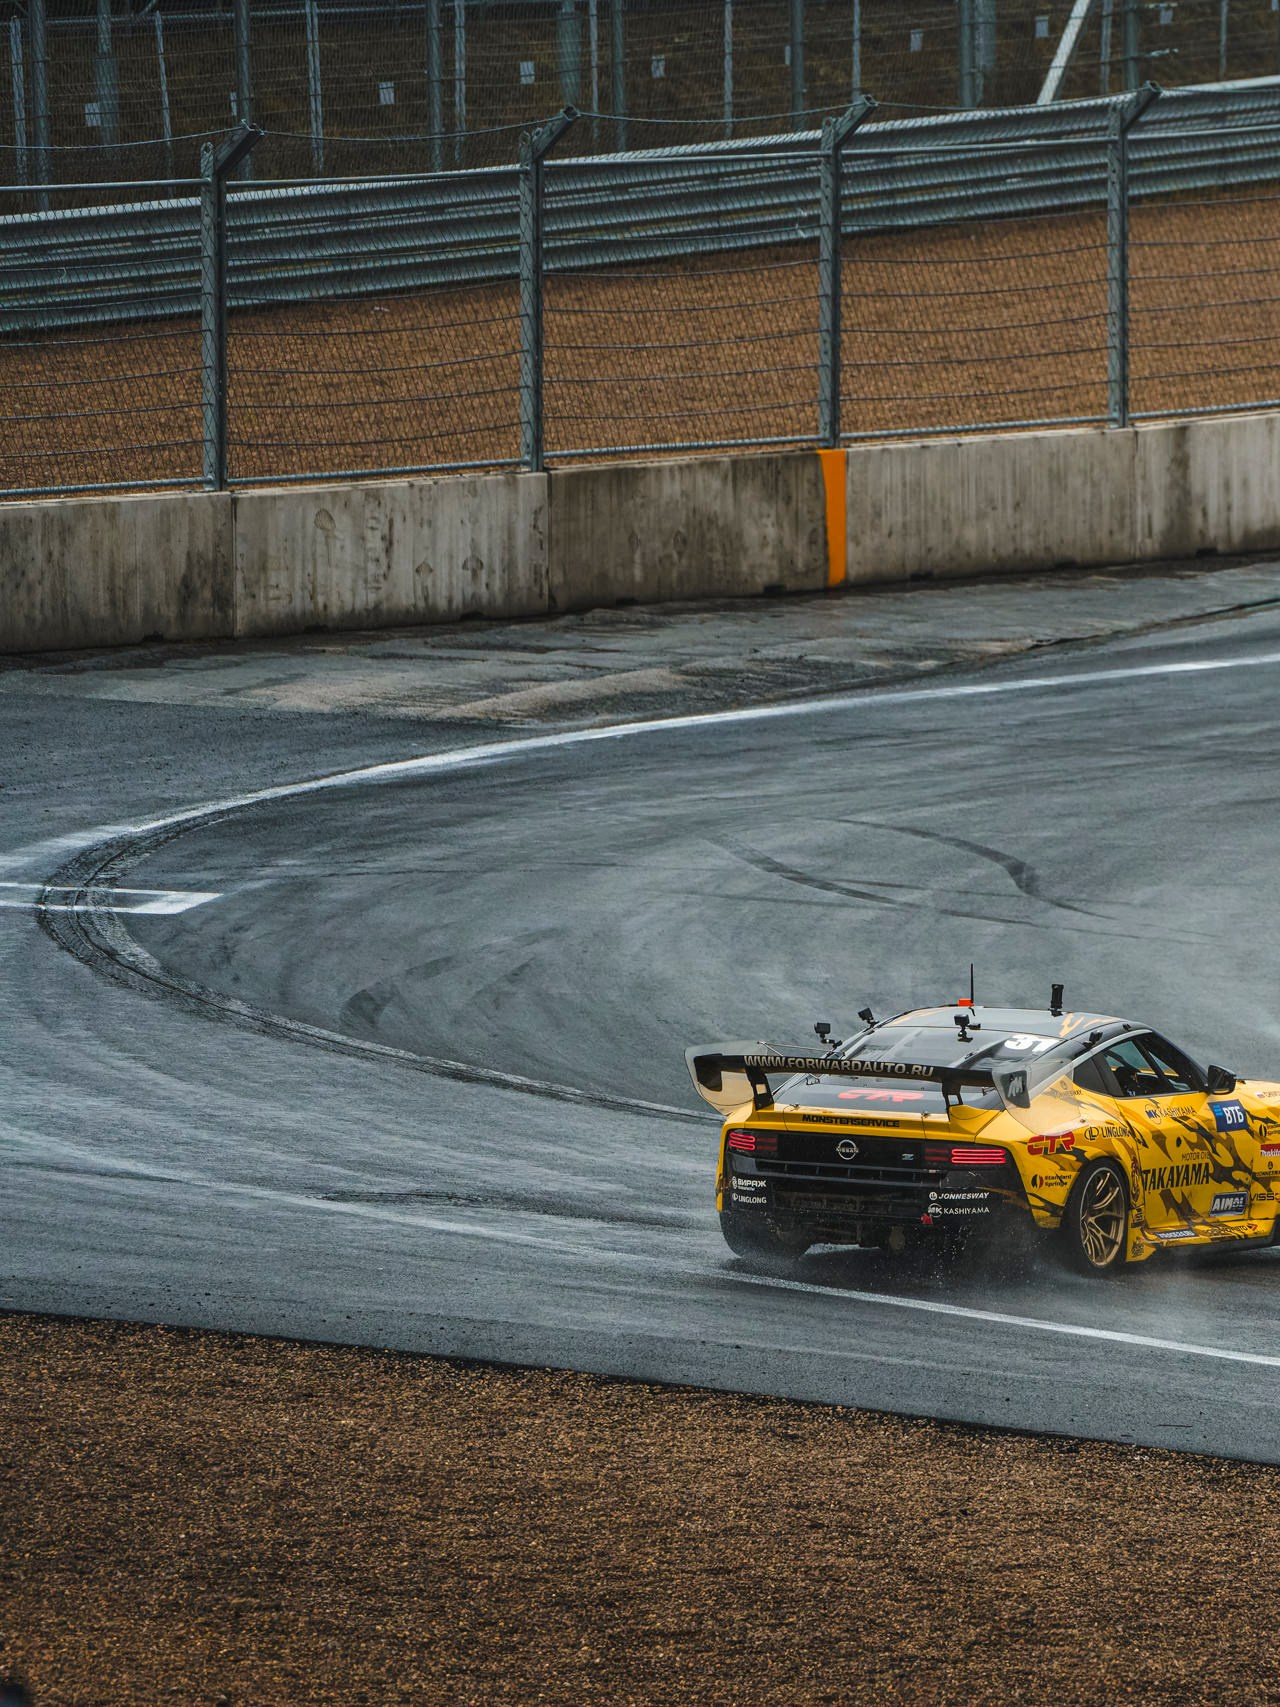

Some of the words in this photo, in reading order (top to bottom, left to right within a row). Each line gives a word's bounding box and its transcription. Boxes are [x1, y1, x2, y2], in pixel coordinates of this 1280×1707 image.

[1004, 1034, 1060, 1052] 31
[744, 1055, 934, 1077] WWW.FORWARDAUTO.RU
[802, 1114, 900, 1128] MONSTERSERVICE
[1223, 1105, 1244, 1125] ВТБ
[1027, 1131, 1075, 1156] CTR
[738, 1178, 767, 1188] ВИРАЖ
[1142, 1163, 1210, 1191] TAKAYAMA
[738, 1195, 767, 1204] LINGLONG
[938, 1192, 990, 1200] JONNESWAY
[943, 1206, 990, 1215] KASHIYAMA
